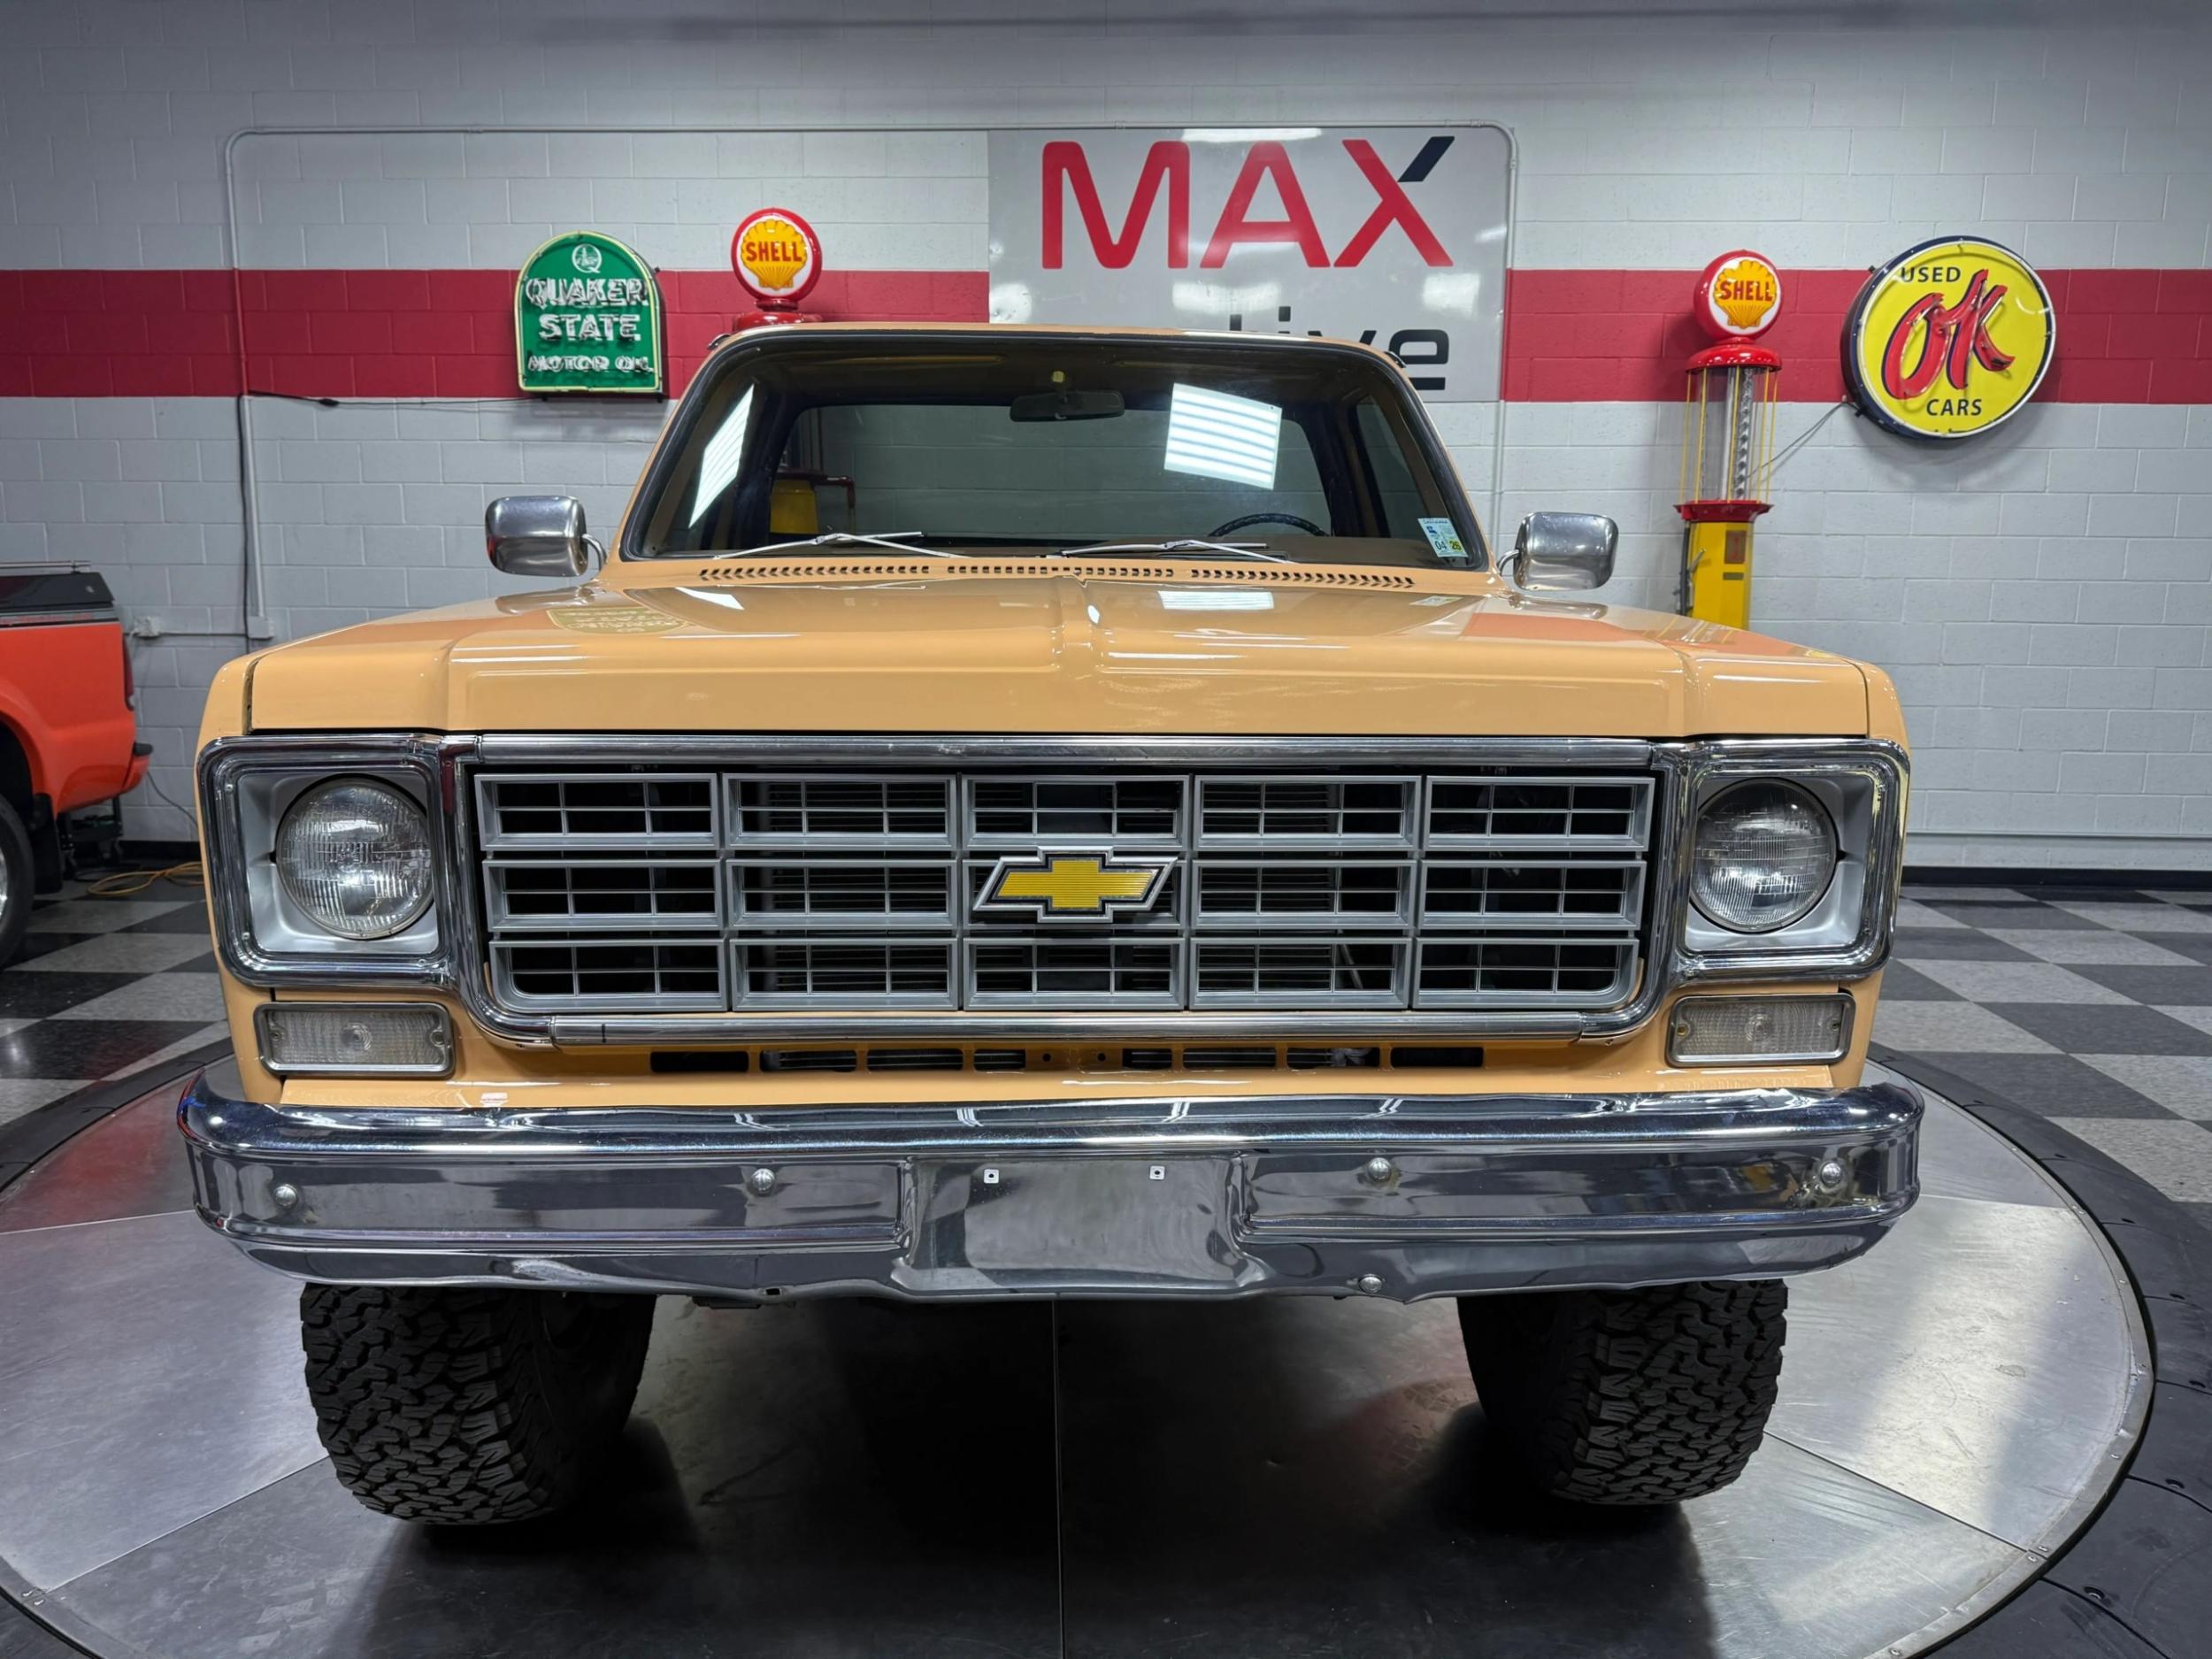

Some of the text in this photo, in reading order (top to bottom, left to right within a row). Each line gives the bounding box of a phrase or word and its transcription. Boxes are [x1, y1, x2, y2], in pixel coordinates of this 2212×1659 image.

[1041, 135, 1455, 269] MAX
[745, 242, 803, 263] SHELL
[1901, 266, 1961, 283] USED
[526, 278, 649, 310] QUAKER
[1719, 280, 1774, 303] SHELL
[539, 314, 641, 342] STATE
[1881, 269, 2015, 400] OK
[528, 355, 655, 373] MOTOR OIL
[1926, 399, 1982, 416] CARS
